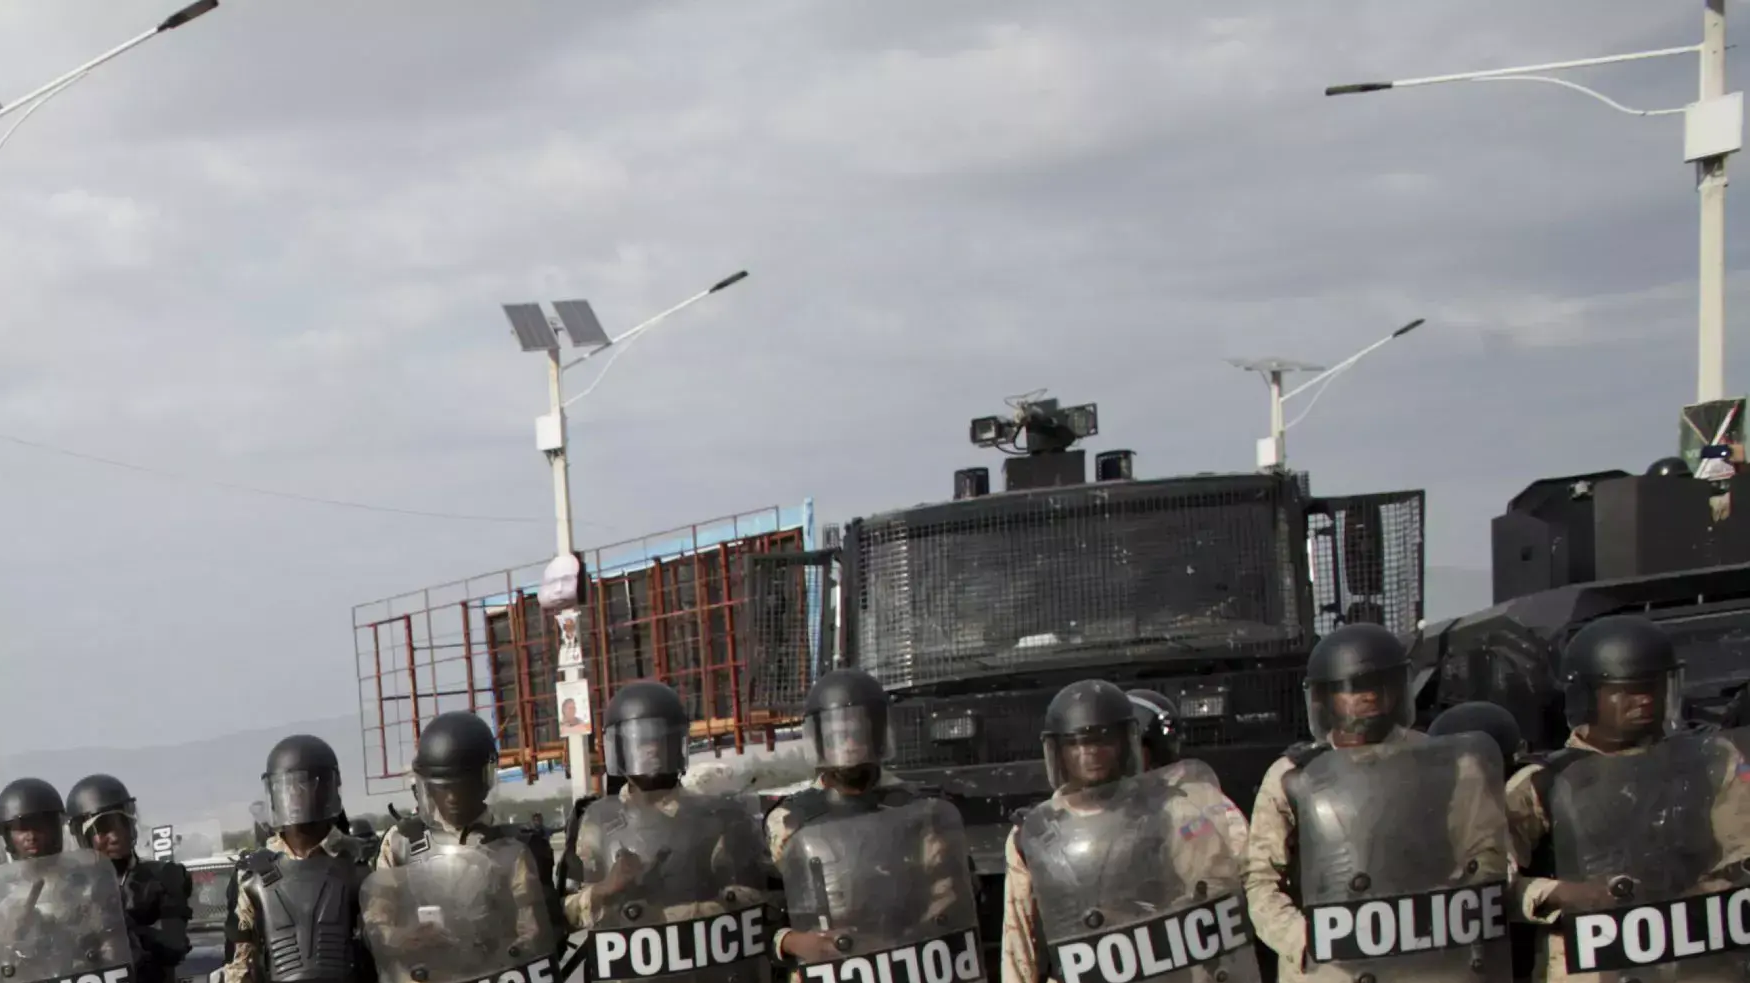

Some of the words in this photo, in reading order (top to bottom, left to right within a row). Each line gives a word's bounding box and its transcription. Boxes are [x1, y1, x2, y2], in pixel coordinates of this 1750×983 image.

[154, 827, 172, 864] POL
[597, 911, 765, 979] POLICE
[1313, 886, 1505, 960] POLICE
[1575, 888, 1750, 969] POLIC
